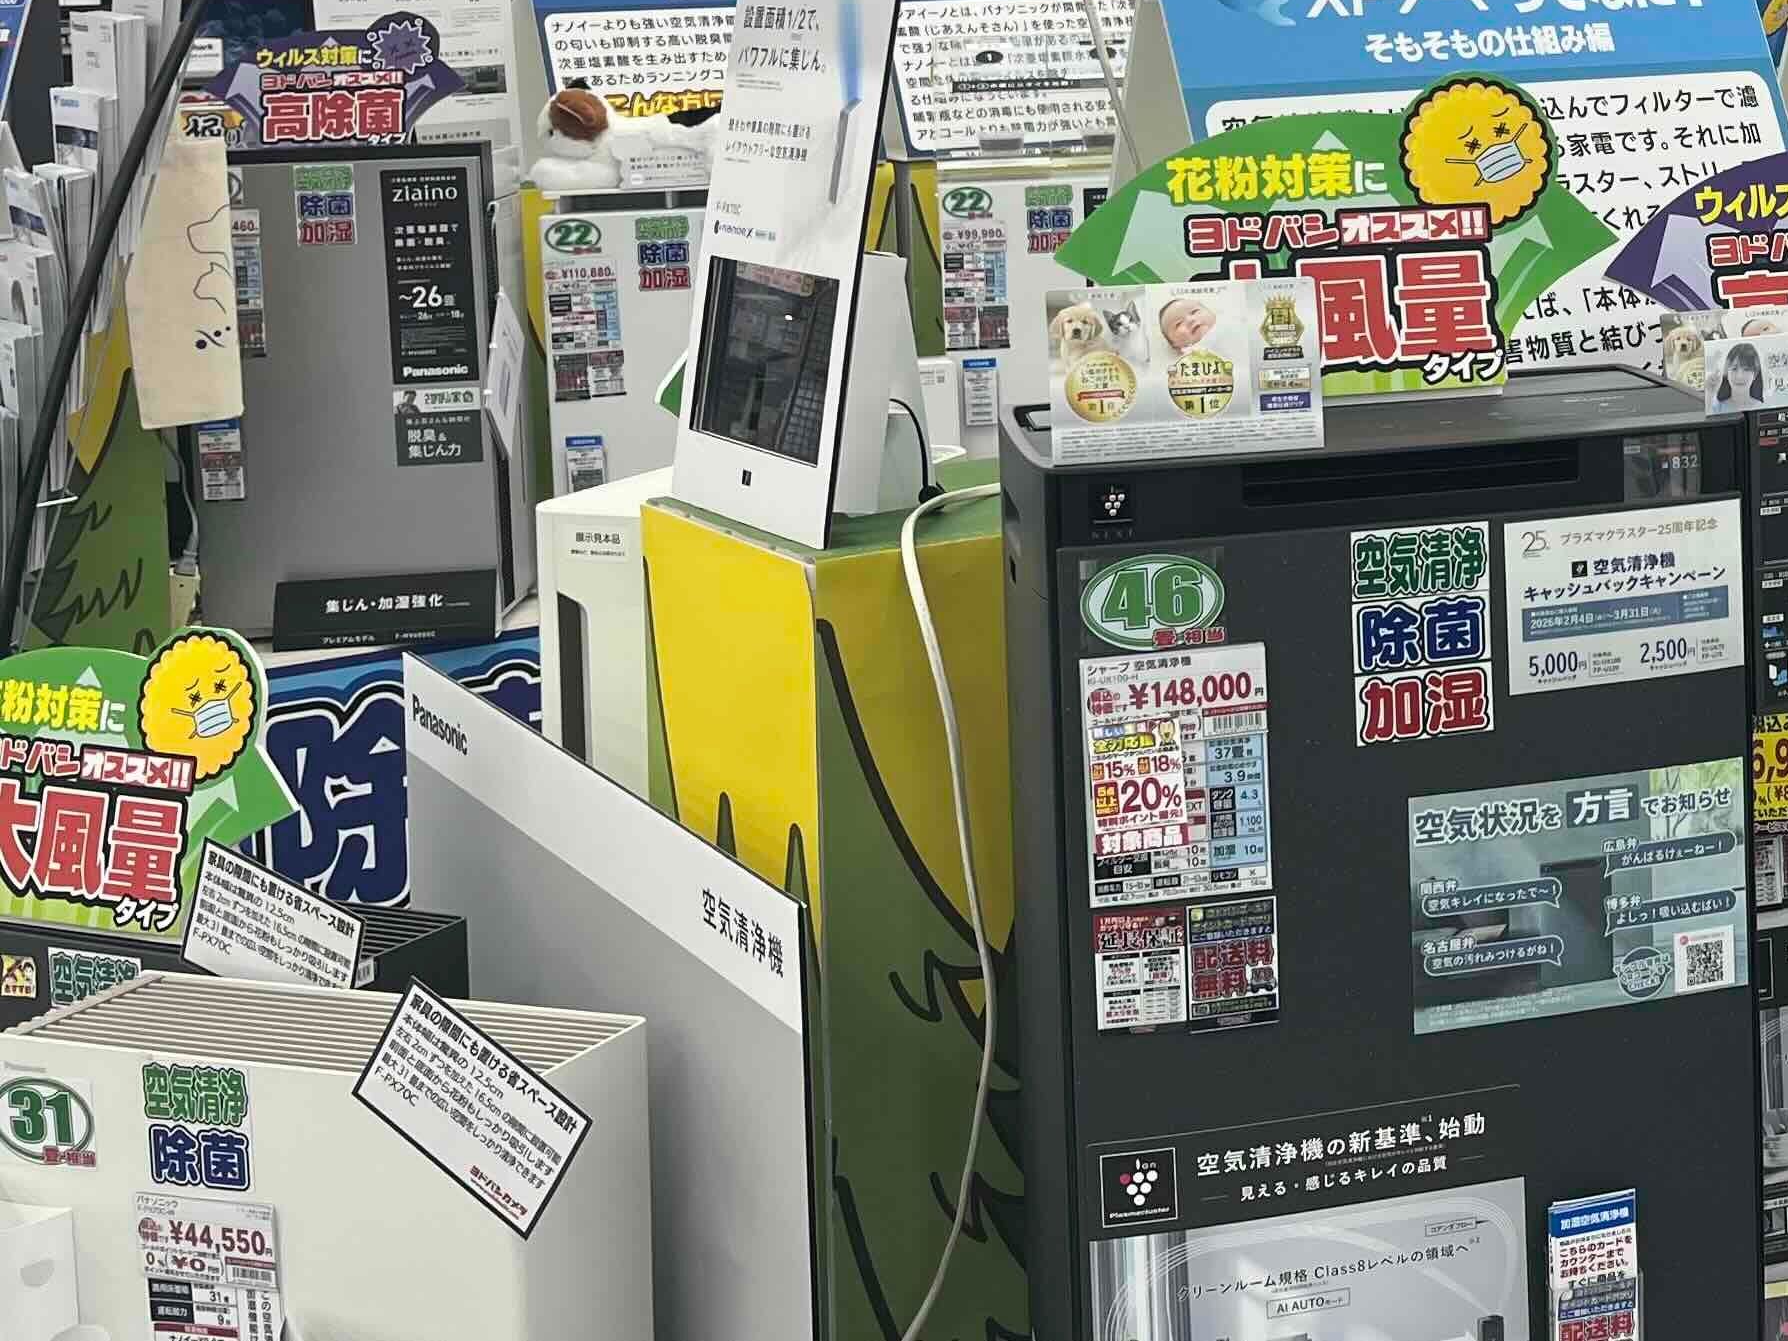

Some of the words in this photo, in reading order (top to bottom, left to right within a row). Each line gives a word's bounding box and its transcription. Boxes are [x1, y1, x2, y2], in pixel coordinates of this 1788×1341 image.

[1364, 22, 1616, 64] そもそもの仕組み編
[260, 70, 405, 92] ヨドバシオススメ!!
[262, 88, 404, 144] 高除菌
[392, 184, 459, 204] ziaino
[1164, 149, 1388, 206] 花粉対策に
[299, 193, 354, 219] 除菌
[949, 190, 987, 212] 22
[1026, 207, 1074, 231] 除菌
[298, 218, 356, 247] 加湿
[553, 223, 594, 247] 22
[1188, 209, 1491, 253] ヨドバシオススメ!!
[638, 242, 690, 267] 除菌
[638, 266, 691, 292] 加湿
[402, 363, 469, 378] Panasonic
[1421, 350, 1510, 385] タイプ
[1353, 525, 1488, 597] 空気清浄
[1592, 550, 1676, 577] 空気清浄機
[1100, 563, 1205, 631] 46
[1523, 565, 1727, 603] キャッシュバックキャンペーン
[324, 593, 443, 615] 集じん・加湿強化
[1360, 596, 1484, 672] 除菌
[1086, 662, 1129, 677] シャープ
[1128, 670, 1253, 710] ¥148,000
[1361, 670, 1489, 744] 加湿
[410, 690, 470, 757] Panasonic
[1120, 777, 1183, 814] 20%
[114, 897, 181, 932] タイプ
[702, 887, 784, 979] 空気清浄機
[141, 1060, 249, 1128] 空気清浄
[7, 1088, 73, 1145] 31
[150, 1127, 252, 1192] 除菌
[1239, 1154, 1449, 1202] 見える・感じるキレイの品質
[168, 1218, 266, 1257] ¥44,550
[1559, 1235, 1633, 1258] こちらのカードを
[1559, 1247, 1625, 1269] カウンターまで
